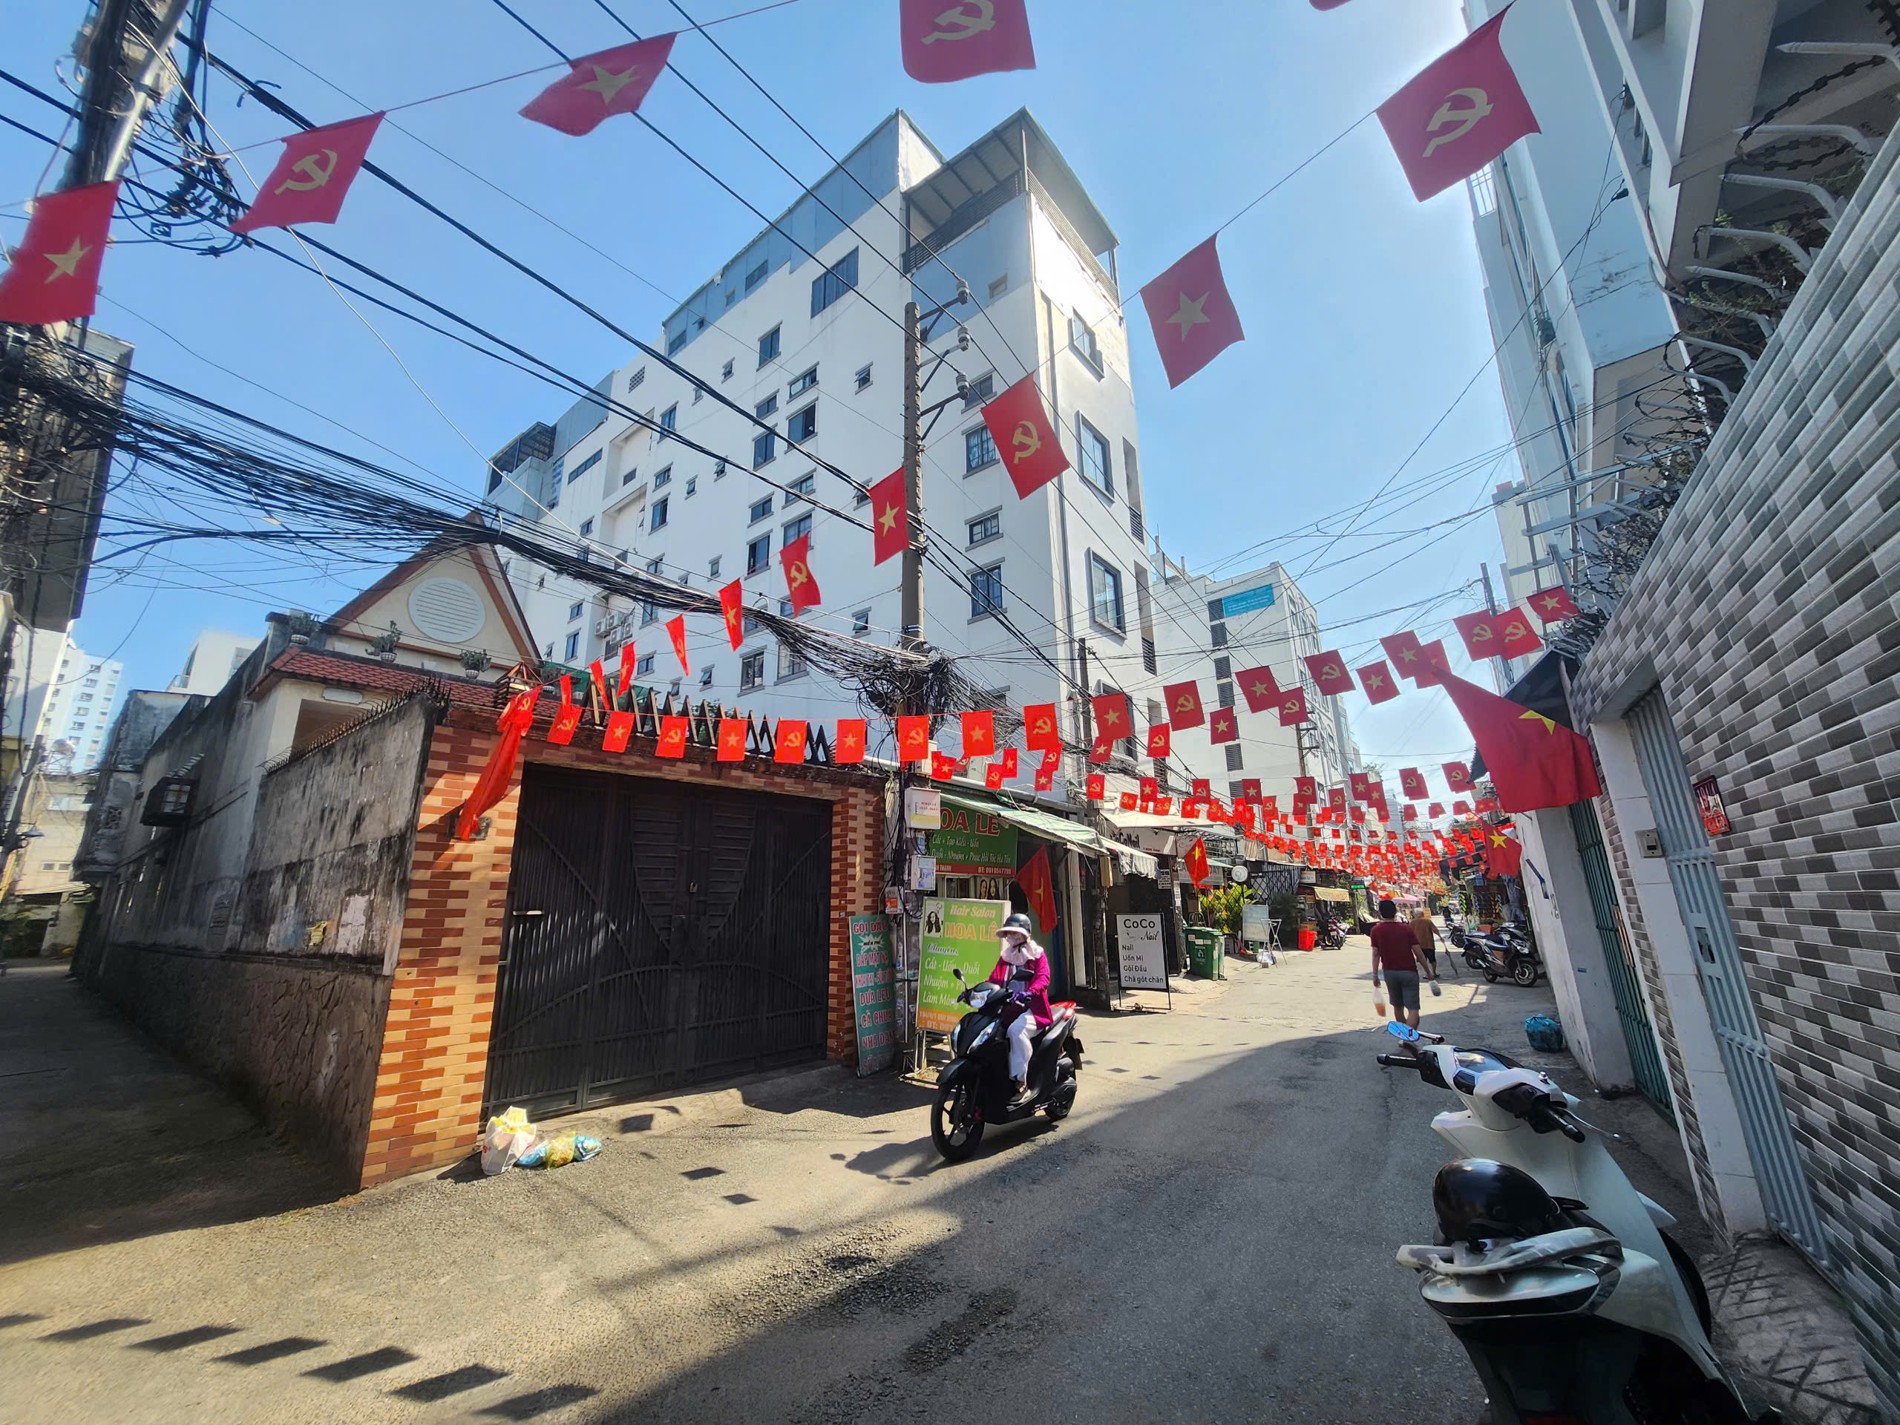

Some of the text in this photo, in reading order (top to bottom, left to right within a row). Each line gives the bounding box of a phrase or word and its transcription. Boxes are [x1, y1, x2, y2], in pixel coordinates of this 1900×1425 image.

[940, 807, 970, 833] OA
[950, 904, 997, 918] Hair Salon
[1124, 919, 1156, 929] CoCo
[946, 922, 977, 941] HOA
[1140, 930, 1160, 941] Nail
[1122, 943, 1134, 951] Nail
[1124, 975, 1136, 983] Chà
[1137, 975, 1148, 984] gót
[923, 992, 938, 1004] Làm
